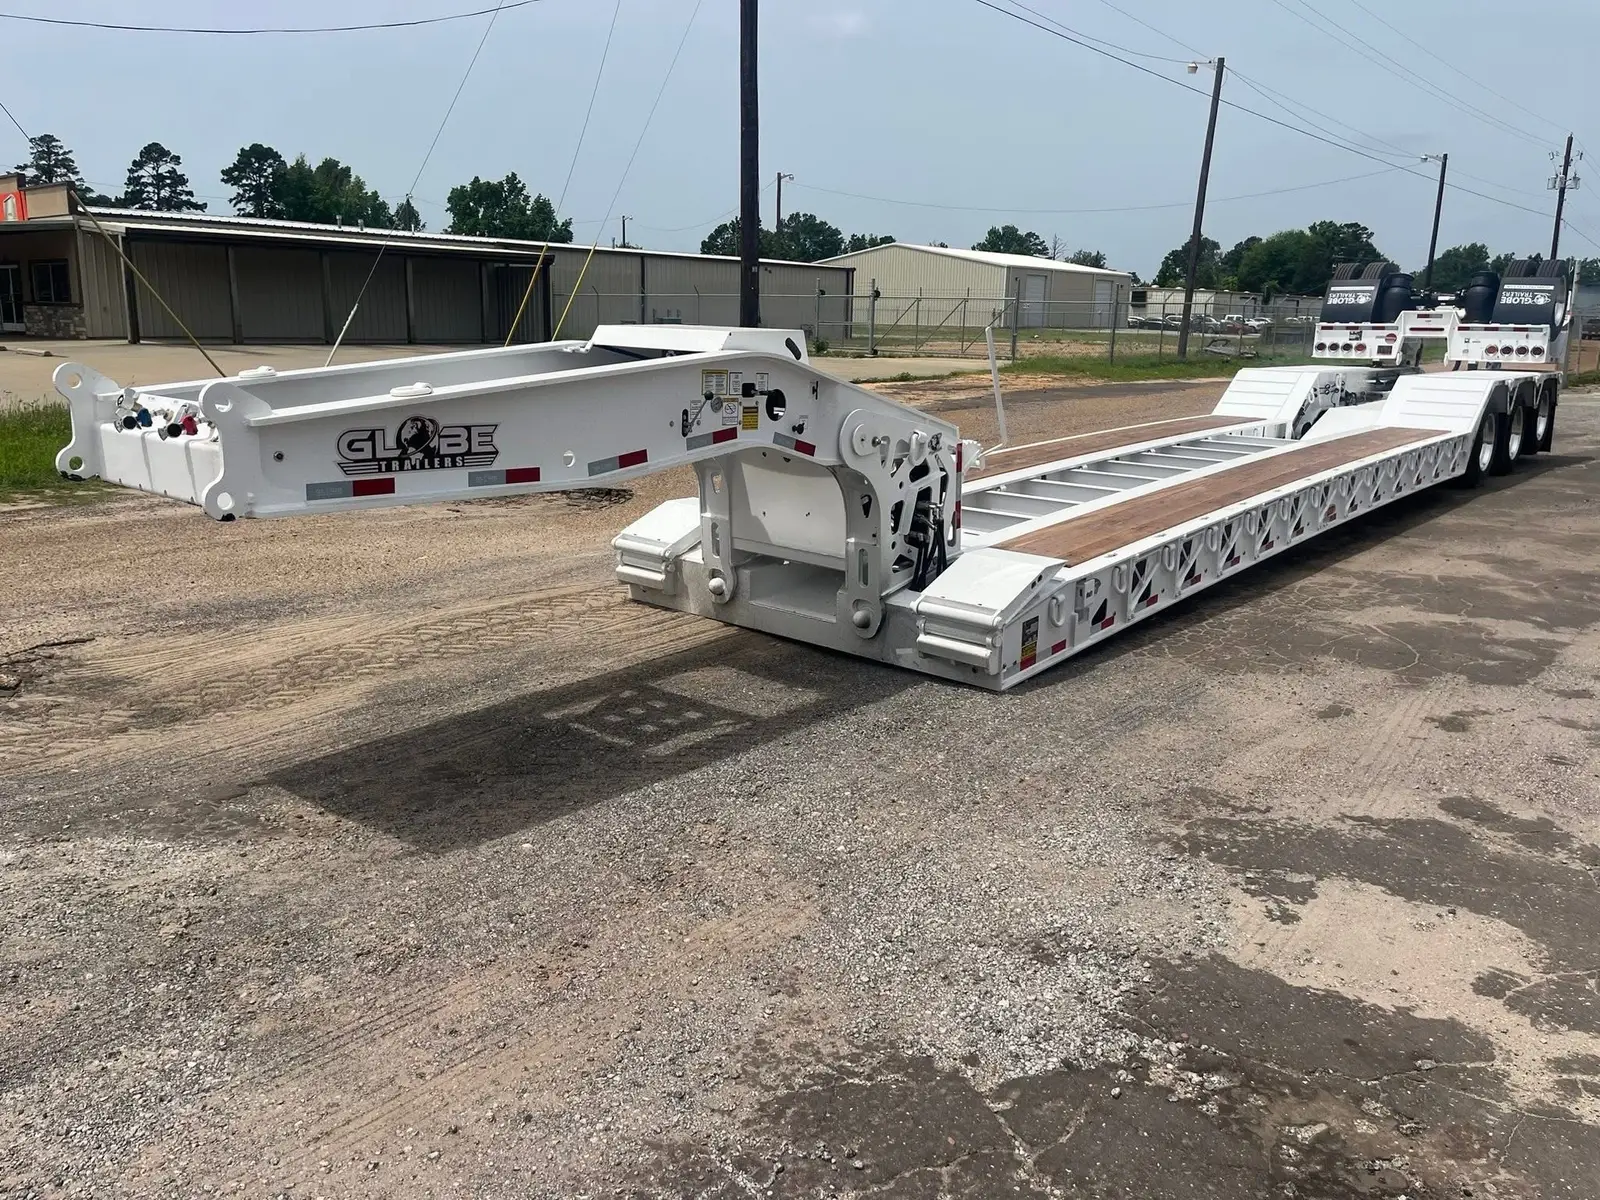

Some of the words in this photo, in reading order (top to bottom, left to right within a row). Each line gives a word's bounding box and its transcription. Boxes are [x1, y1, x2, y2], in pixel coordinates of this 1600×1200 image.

[1327, 297, 1355, 305] GLOBE
[1500, 296, 1532, 305] GLOBE
[337, 417, 499, 460] GLOBE
[380, 456, 464, 472] TRAILERS
